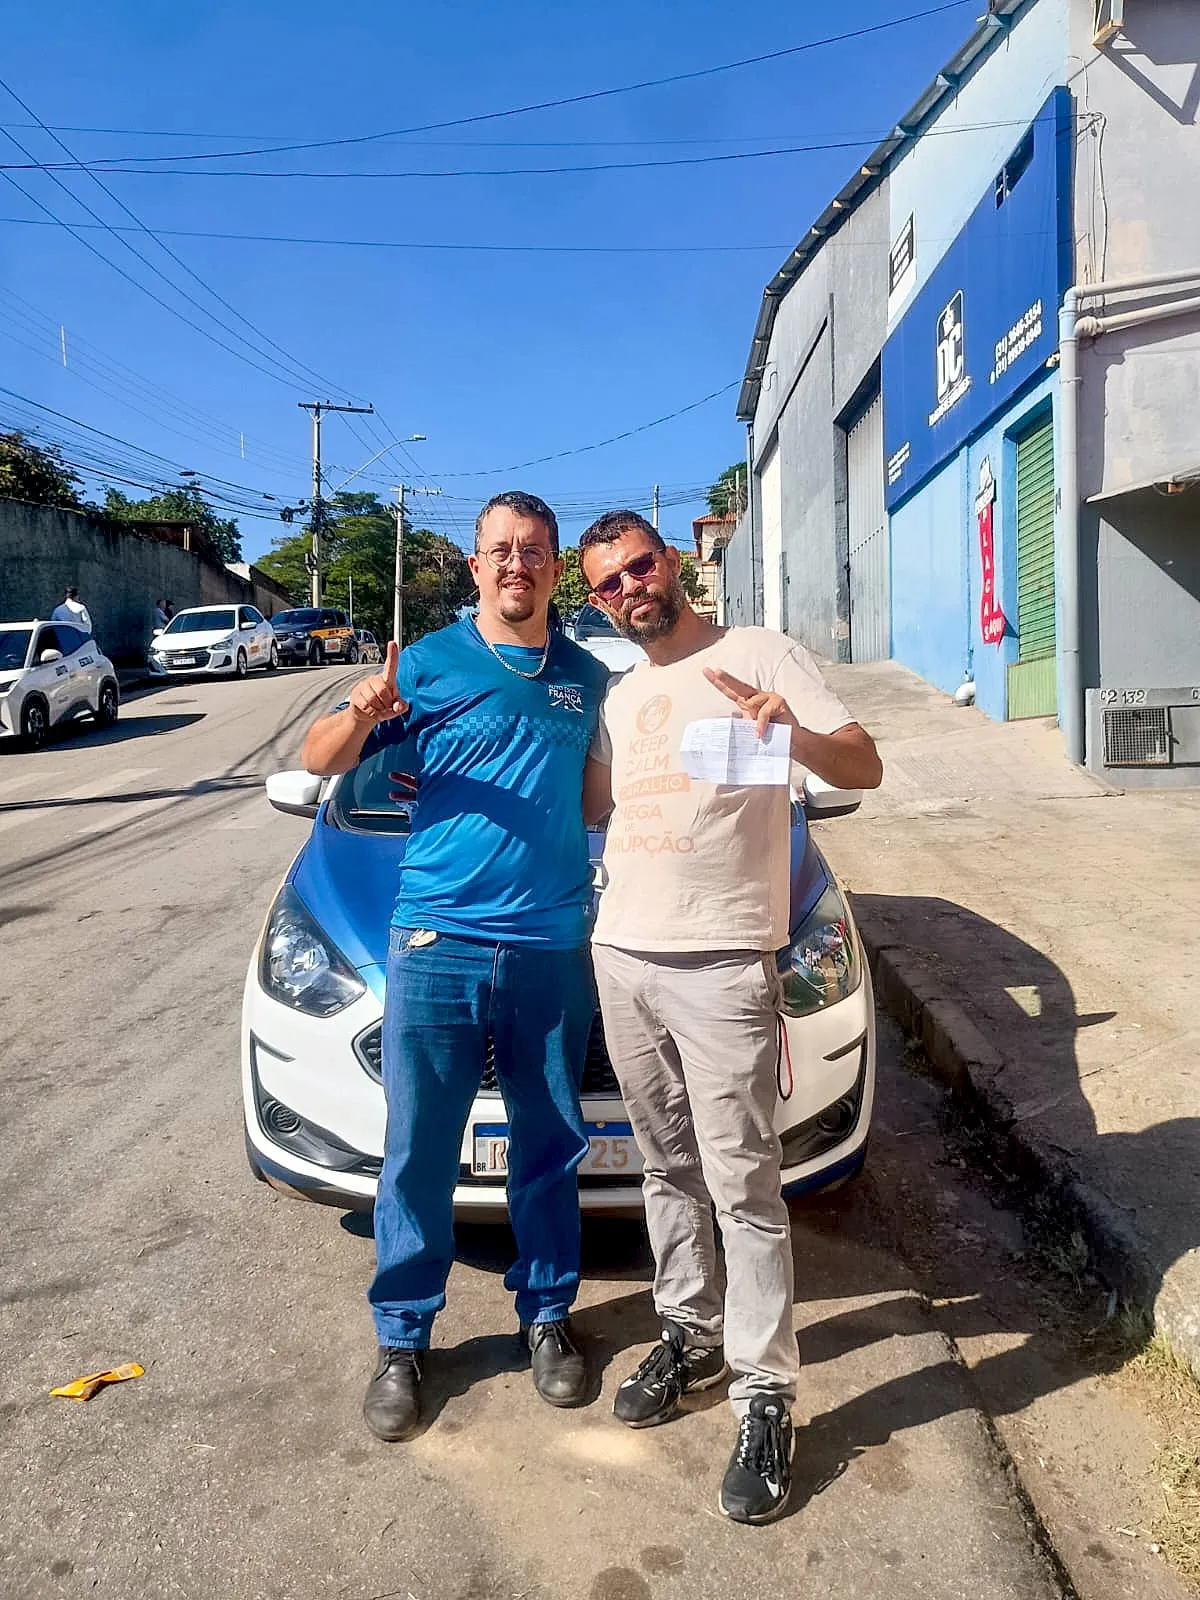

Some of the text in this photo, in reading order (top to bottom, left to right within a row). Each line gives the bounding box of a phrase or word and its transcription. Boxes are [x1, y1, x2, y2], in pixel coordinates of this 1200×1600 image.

[982, 507, 990, 641] PLACAS
[548, 688, 582, 705] FRANÇA
[629, 734, 669, 754] KEEP
[476, 1162, 487, 1171] BR
